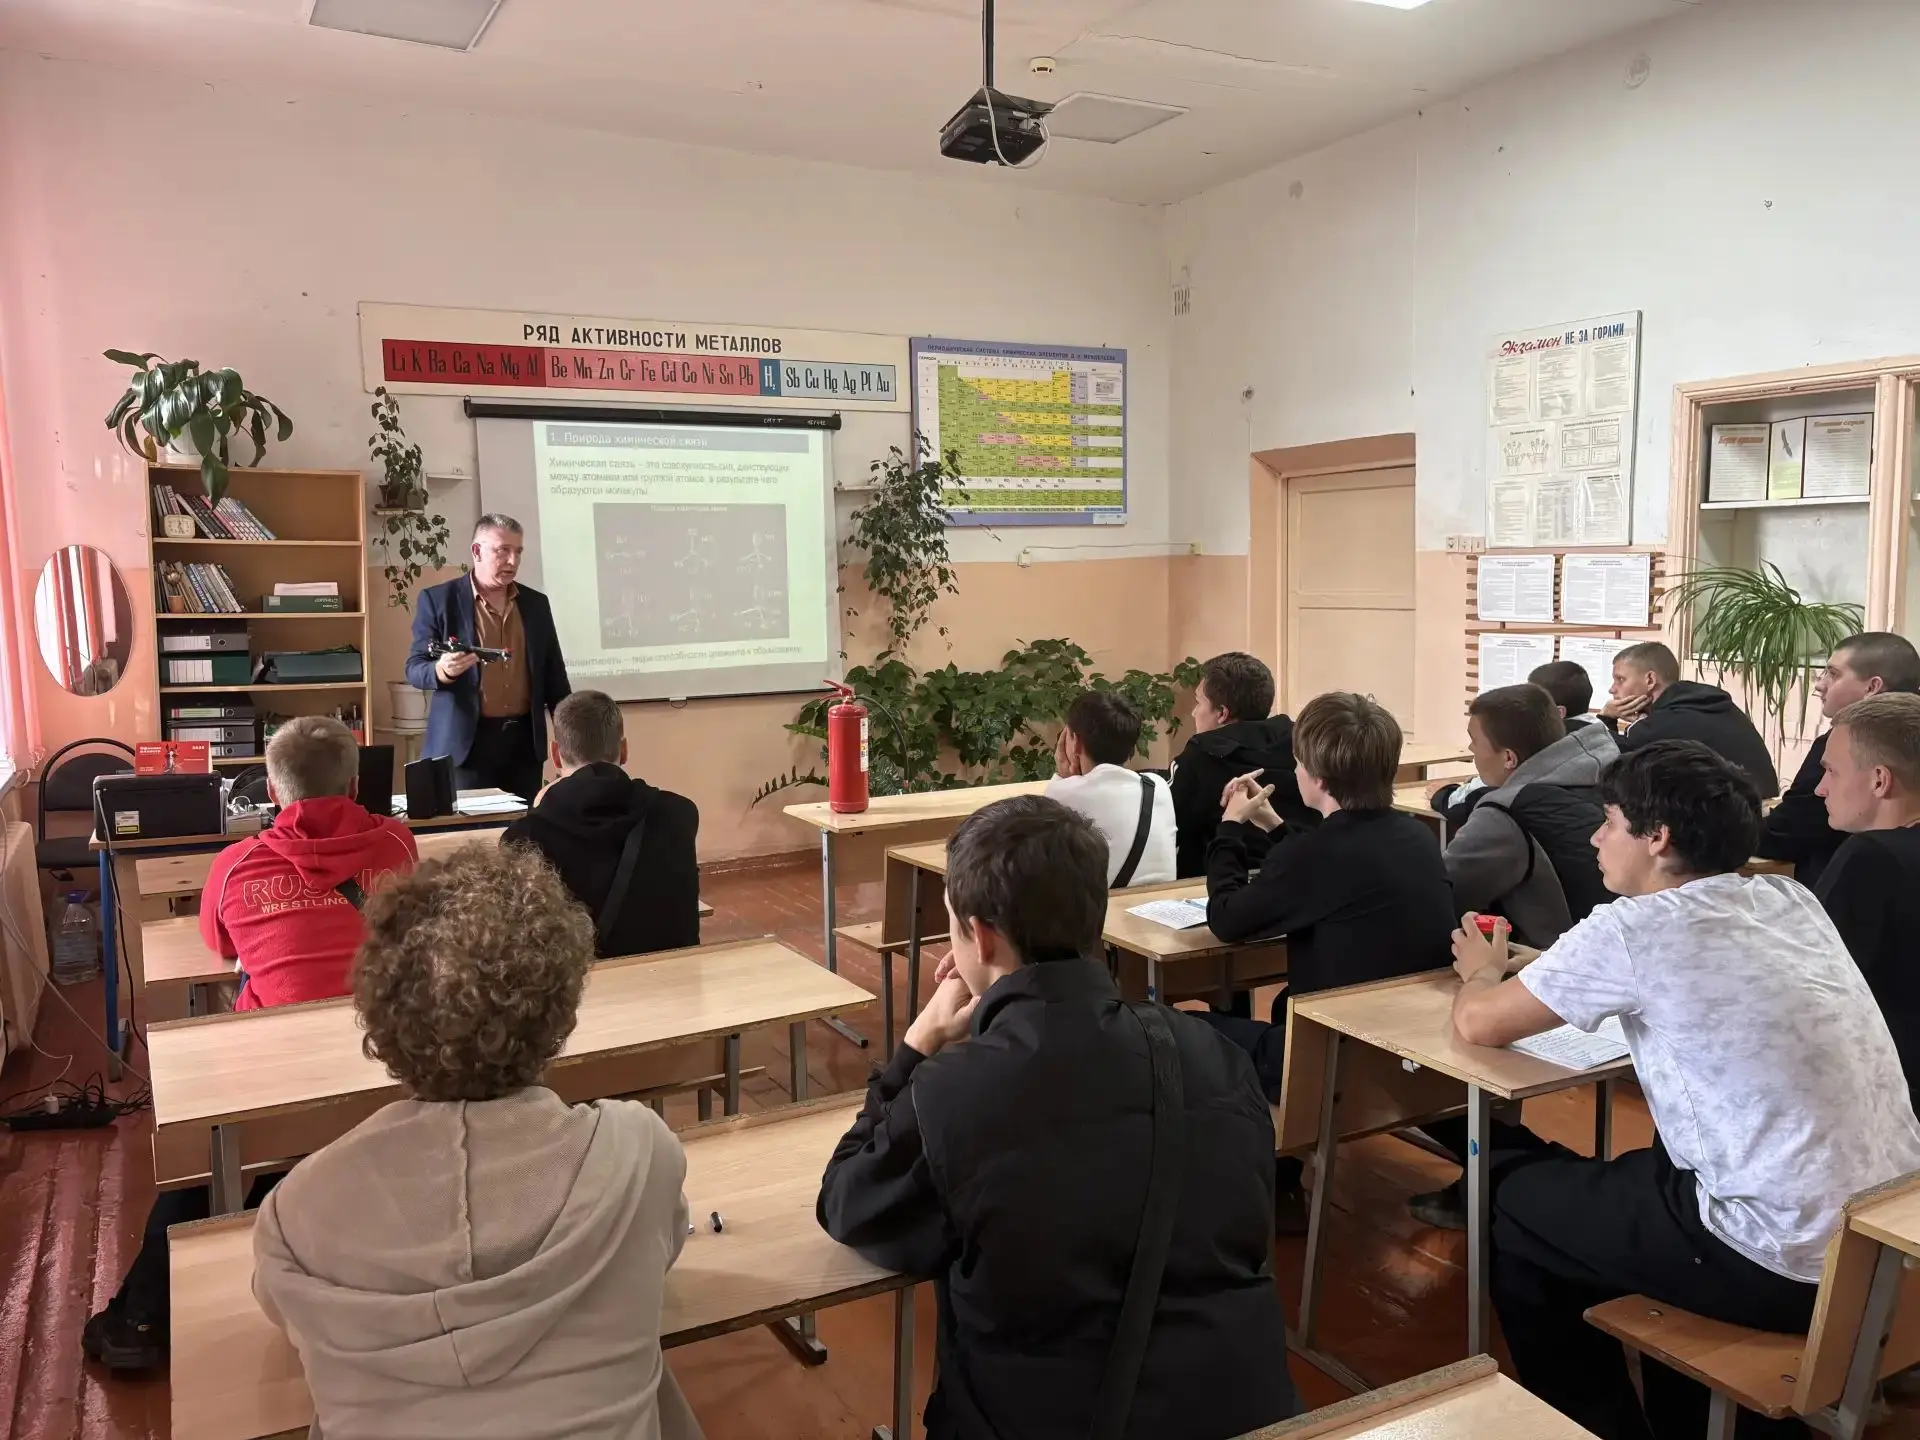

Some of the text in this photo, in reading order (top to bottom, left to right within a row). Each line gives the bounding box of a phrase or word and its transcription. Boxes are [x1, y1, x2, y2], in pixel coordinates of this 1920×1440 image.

[523, 324, 782, 354] РЯД АКТИВНОСТИ МЕТАЛЛОВ
[1499, 322, 1625, 357] Экзамен НЕ ЗА ГОРАМИ
[392, 347, 405, 372] Li
[411, 348, 423, 373] K
[428, 349, 447, 374] Ba
[453, 350, 471, 374] Ca
[477, 351, 495, 375] Na
[500, 352, 520, 380] Mg
[551, 355, 568, 378] Be
[573, 356, 592, 380] Mn
[599, 357, 614, 380] Zn
[619, 358, 635, 380] Cr
[641, 359, 656, 382] Fe
[661, 360, 677, 383] Cd
[682, 361, 697, 384] Co
[702, 361, 715, 385] Ni
[719, 363, 734, 385] Sn
[739, 364, 754, 386] Pb
[785, 366, 800, 389] Sb
[805, 367, 820, 389] Cu
[824, 369, 838, 395] Hg
[842, 369, 857, 395] Ag
[876, 371, 890, 393] Au
[564, 432, 611, 445] Природа
[549, 457, 606, 469] Химическая
[243, 868, 396, 908] RUIA
[261, 897, 350, 914] WRESTLING
